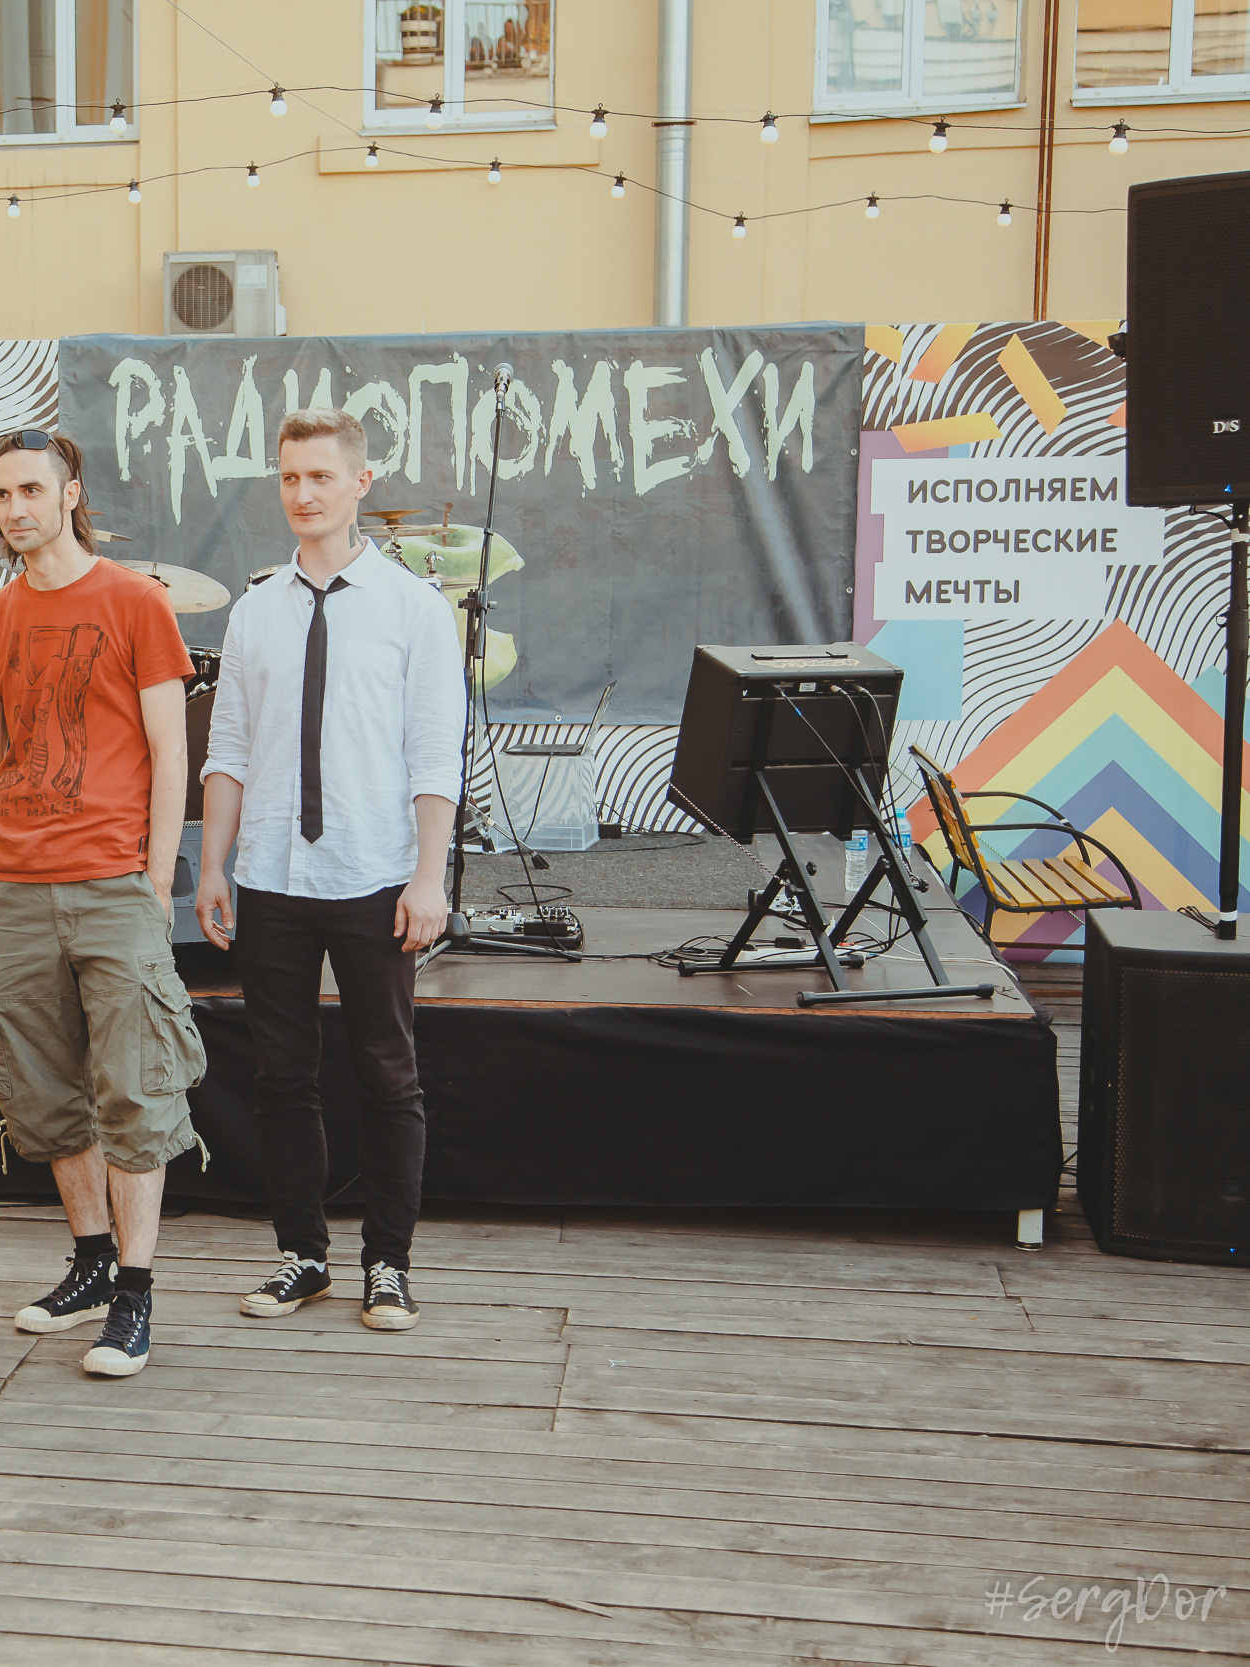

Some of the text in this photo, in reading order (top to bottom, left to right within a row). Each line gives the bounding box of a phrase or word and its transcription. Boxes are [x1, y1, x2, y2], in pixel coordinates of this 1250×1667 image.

[907, 476, 1119, 504] ИСПОЛНЯЕМ
[905, 528, 1119, 554] ТВОРЧЕСКИЕ
[904, 579, 1021, 604] МЕЧТЫ
[27, 799, 84, 817] MAKER
